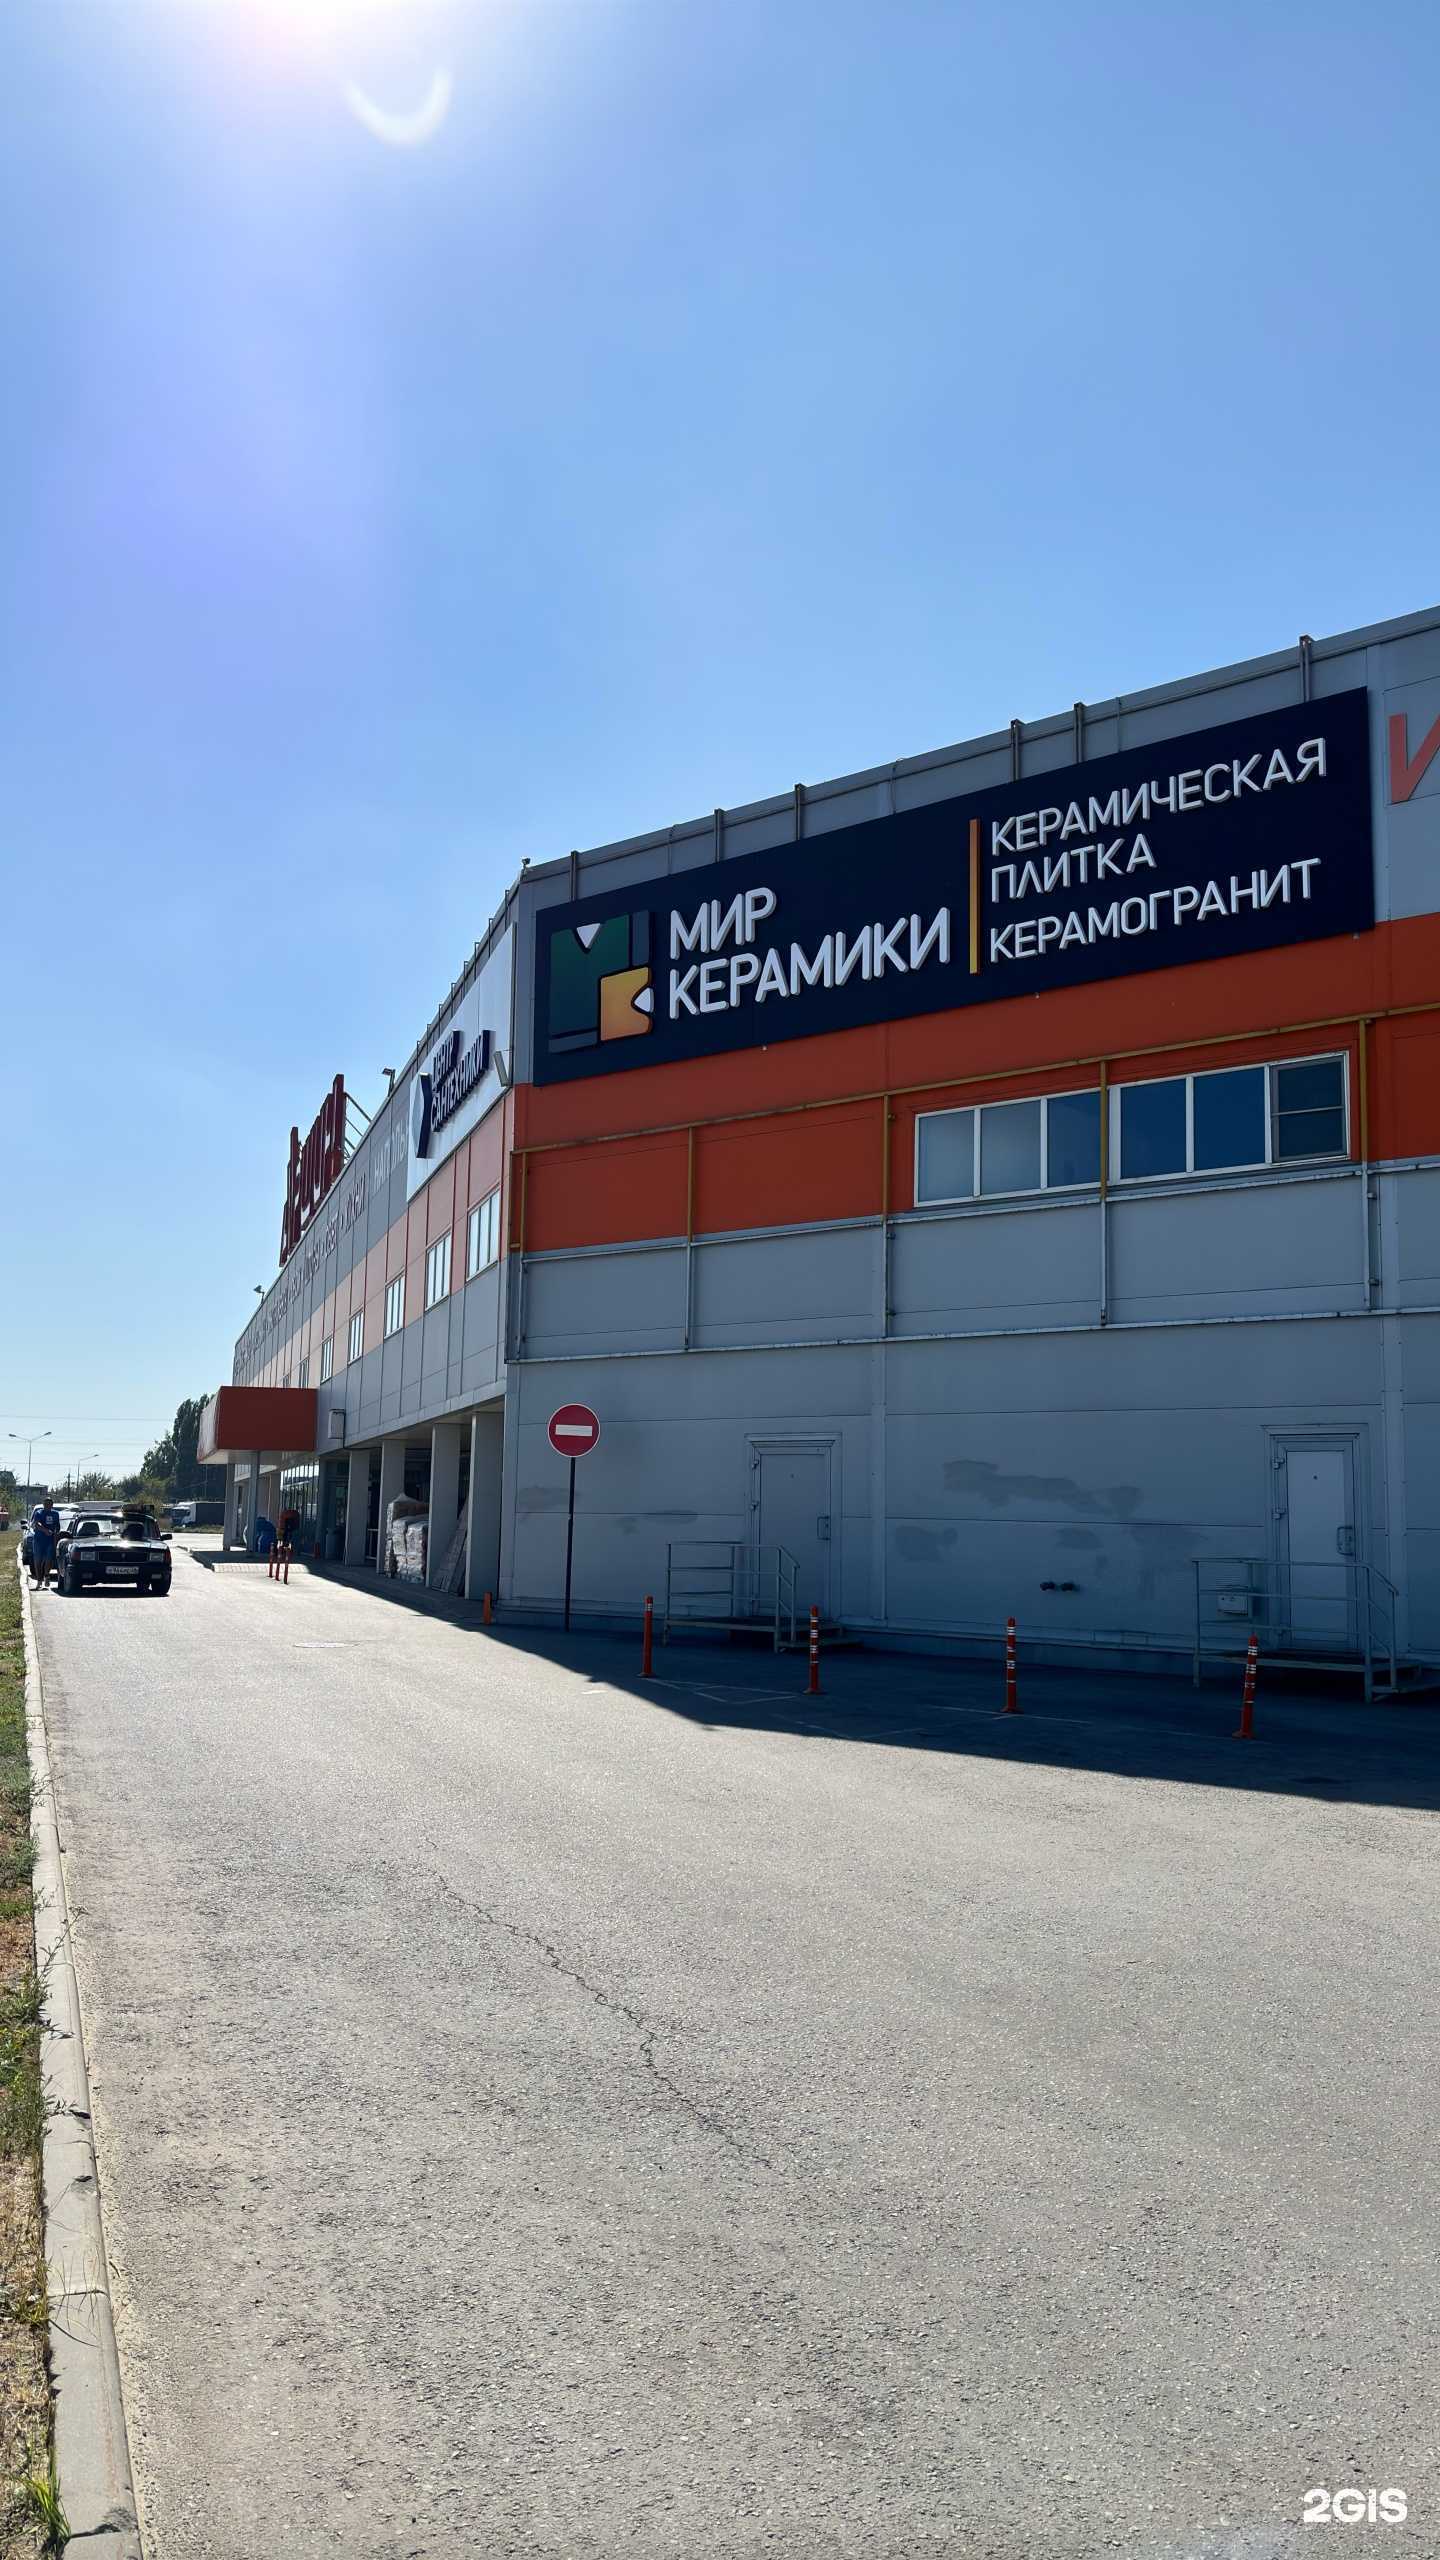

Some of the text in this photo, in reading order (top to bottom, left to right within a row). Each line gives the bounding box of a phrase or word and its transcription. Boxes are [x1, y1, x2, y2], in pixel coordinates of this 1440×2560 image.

[991, 737, 1327, 856] КЕРАМИЧЕСКАЯ
[990, 857, 1322, 963] КЕРАМОГРАНИТ
[991, 833, 1157, 903] ПЛИТКА
[669, 907, 950, 1020] КЕРАМИКИ
[670, 887, 777, 960] МИР
